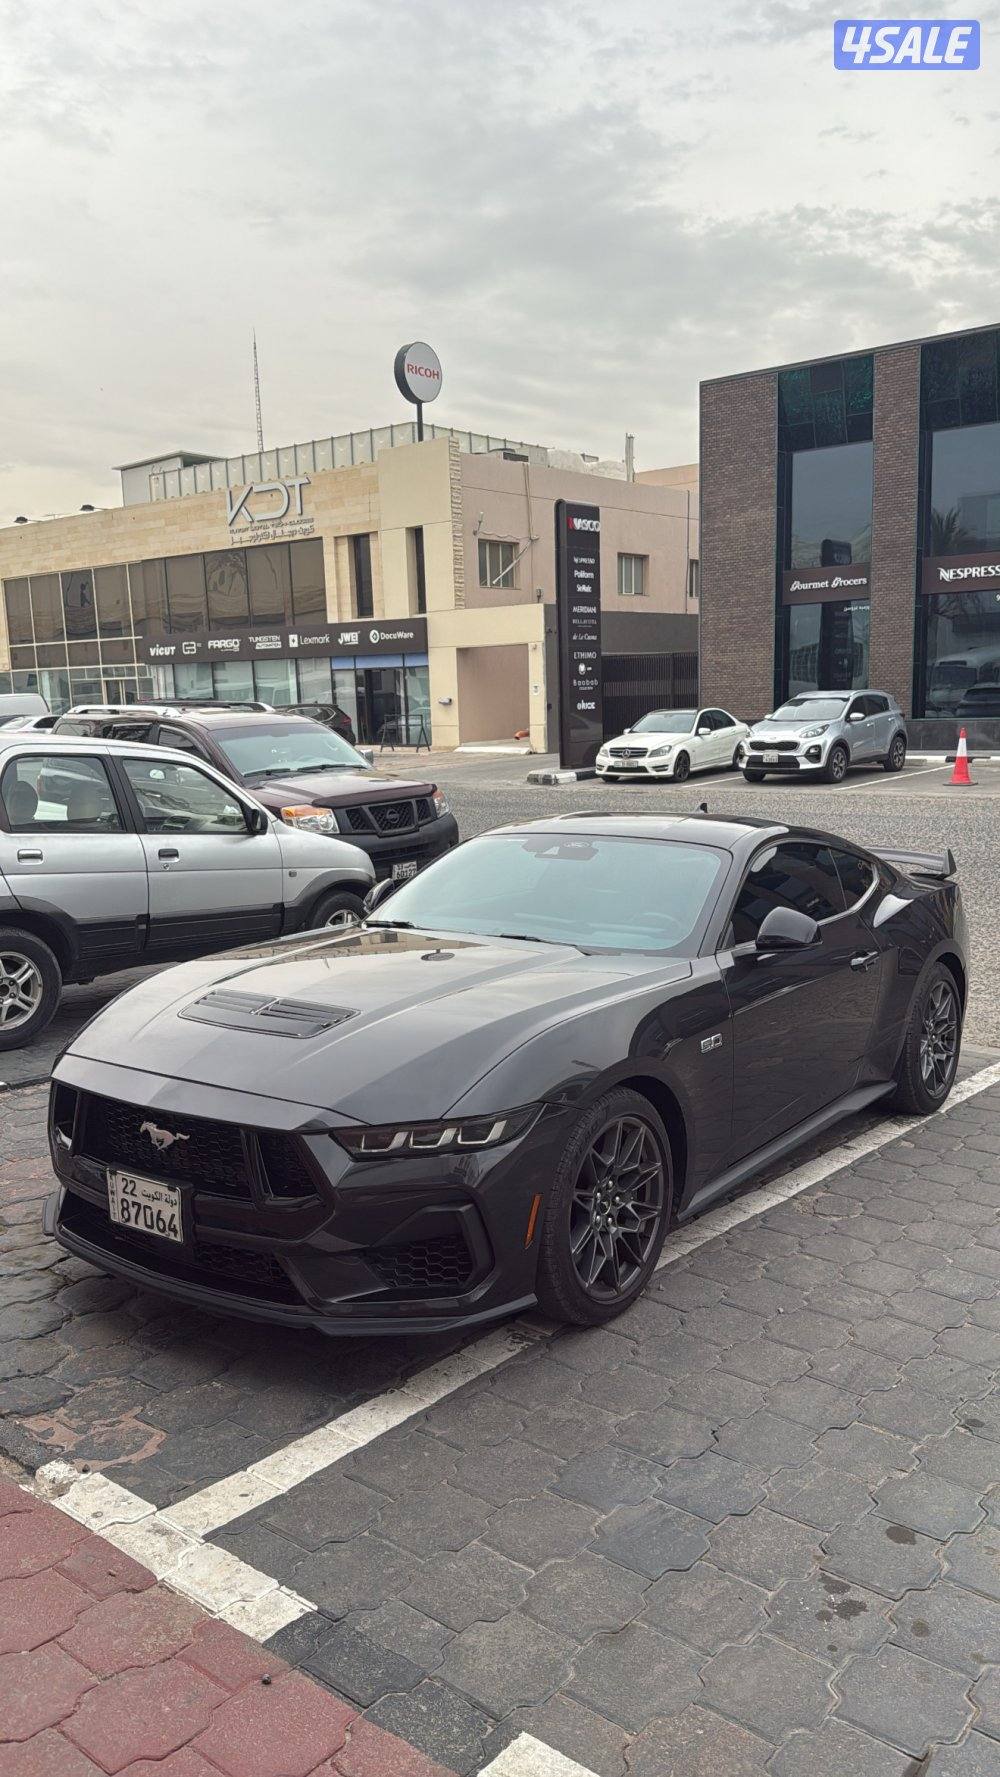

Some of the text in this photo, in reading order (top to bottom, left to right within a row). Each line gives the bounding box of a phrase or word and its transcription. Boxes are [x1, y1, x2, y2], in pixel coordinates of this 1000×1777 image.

[406, 363, 440, 380] RICOH
[226, 476, 311, 527] KDT
[790, 576, 868, 592] Gourmet Grocers
[300, 633, 330, 645] Lexmark
[338, 631, 359, 645] JWEI
[380, 630, 414, 641] DocuWare
[208, 639, 240, 649] FARGO
[574, 651, 597, 660] ETHIMO
[121, 1177, 138, 1198] 22
[120, 1198, 179, 1238] 87064
